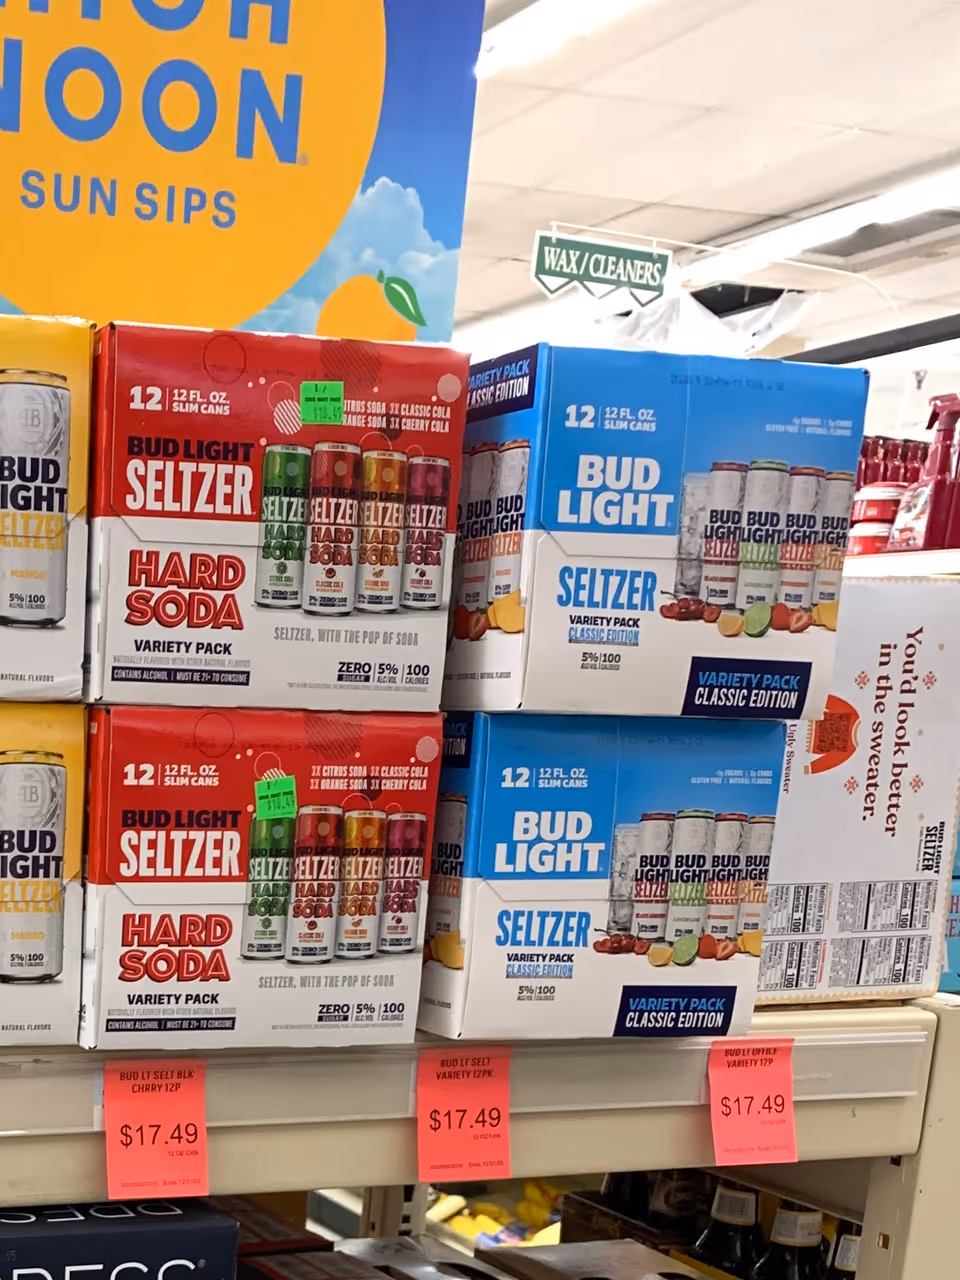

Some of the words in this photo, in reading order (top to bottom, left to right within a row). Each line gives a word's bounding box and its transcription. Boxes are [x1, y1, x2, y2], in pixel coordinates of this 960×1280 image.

[20, 169, 118, 218] SUN
[134, 182, 237, 229] SIPS
[127, 436, 181, 458] BUD
[184, 440, 254, 462] LIGHT
[125, 460, 254, 515] SELTZER
[577, 455, 660, 490] BUD
[557, 490, 674, 527] LIGHT
[129, 550, 246, 590] HARD
[557, 566, 657, 611] SELTZER
[125, 590, 243, 630] SODA
[274, 627, 314, 643] SELTZER,
[318, 629, 338, 643] WITH
[341, 629, 359, 644] THE
[362, 631, 379, 644] POP
[382, 632, 392, 645] OF
[396, 633, 418, 646] SODA
[338, 662, 371, 675] ZERO
[879, 643, 898, 668] in
[900, 627, 924, 695] You'd
[695, 687, 743, 707] CLASSIC
[747, 691, 797, 709] EDITION
[698, 671, 758, 689] VARIETY
[763, 674, 800, 690] PACK
[874, 674, 892, 713] the
[894, 702, 915, 757] look
[311, 766, 320, 777] 3X
[322, 766, 347, 777] CITRUS
[349, 767, 367, 777] SODA
[371, 767, 379, 777] 3X
[381, 766, 408, 778] CLASSIC
[411, 767, 428, 778] COLA
[862, 721, 883, 821] sweater.
[885, 762, 908, 838] better
[430, 1108, 501, 1132] $17.49
[721, 1095, 785, 1117] $17.49
[120, 1123, 198, 1148] $17.49
